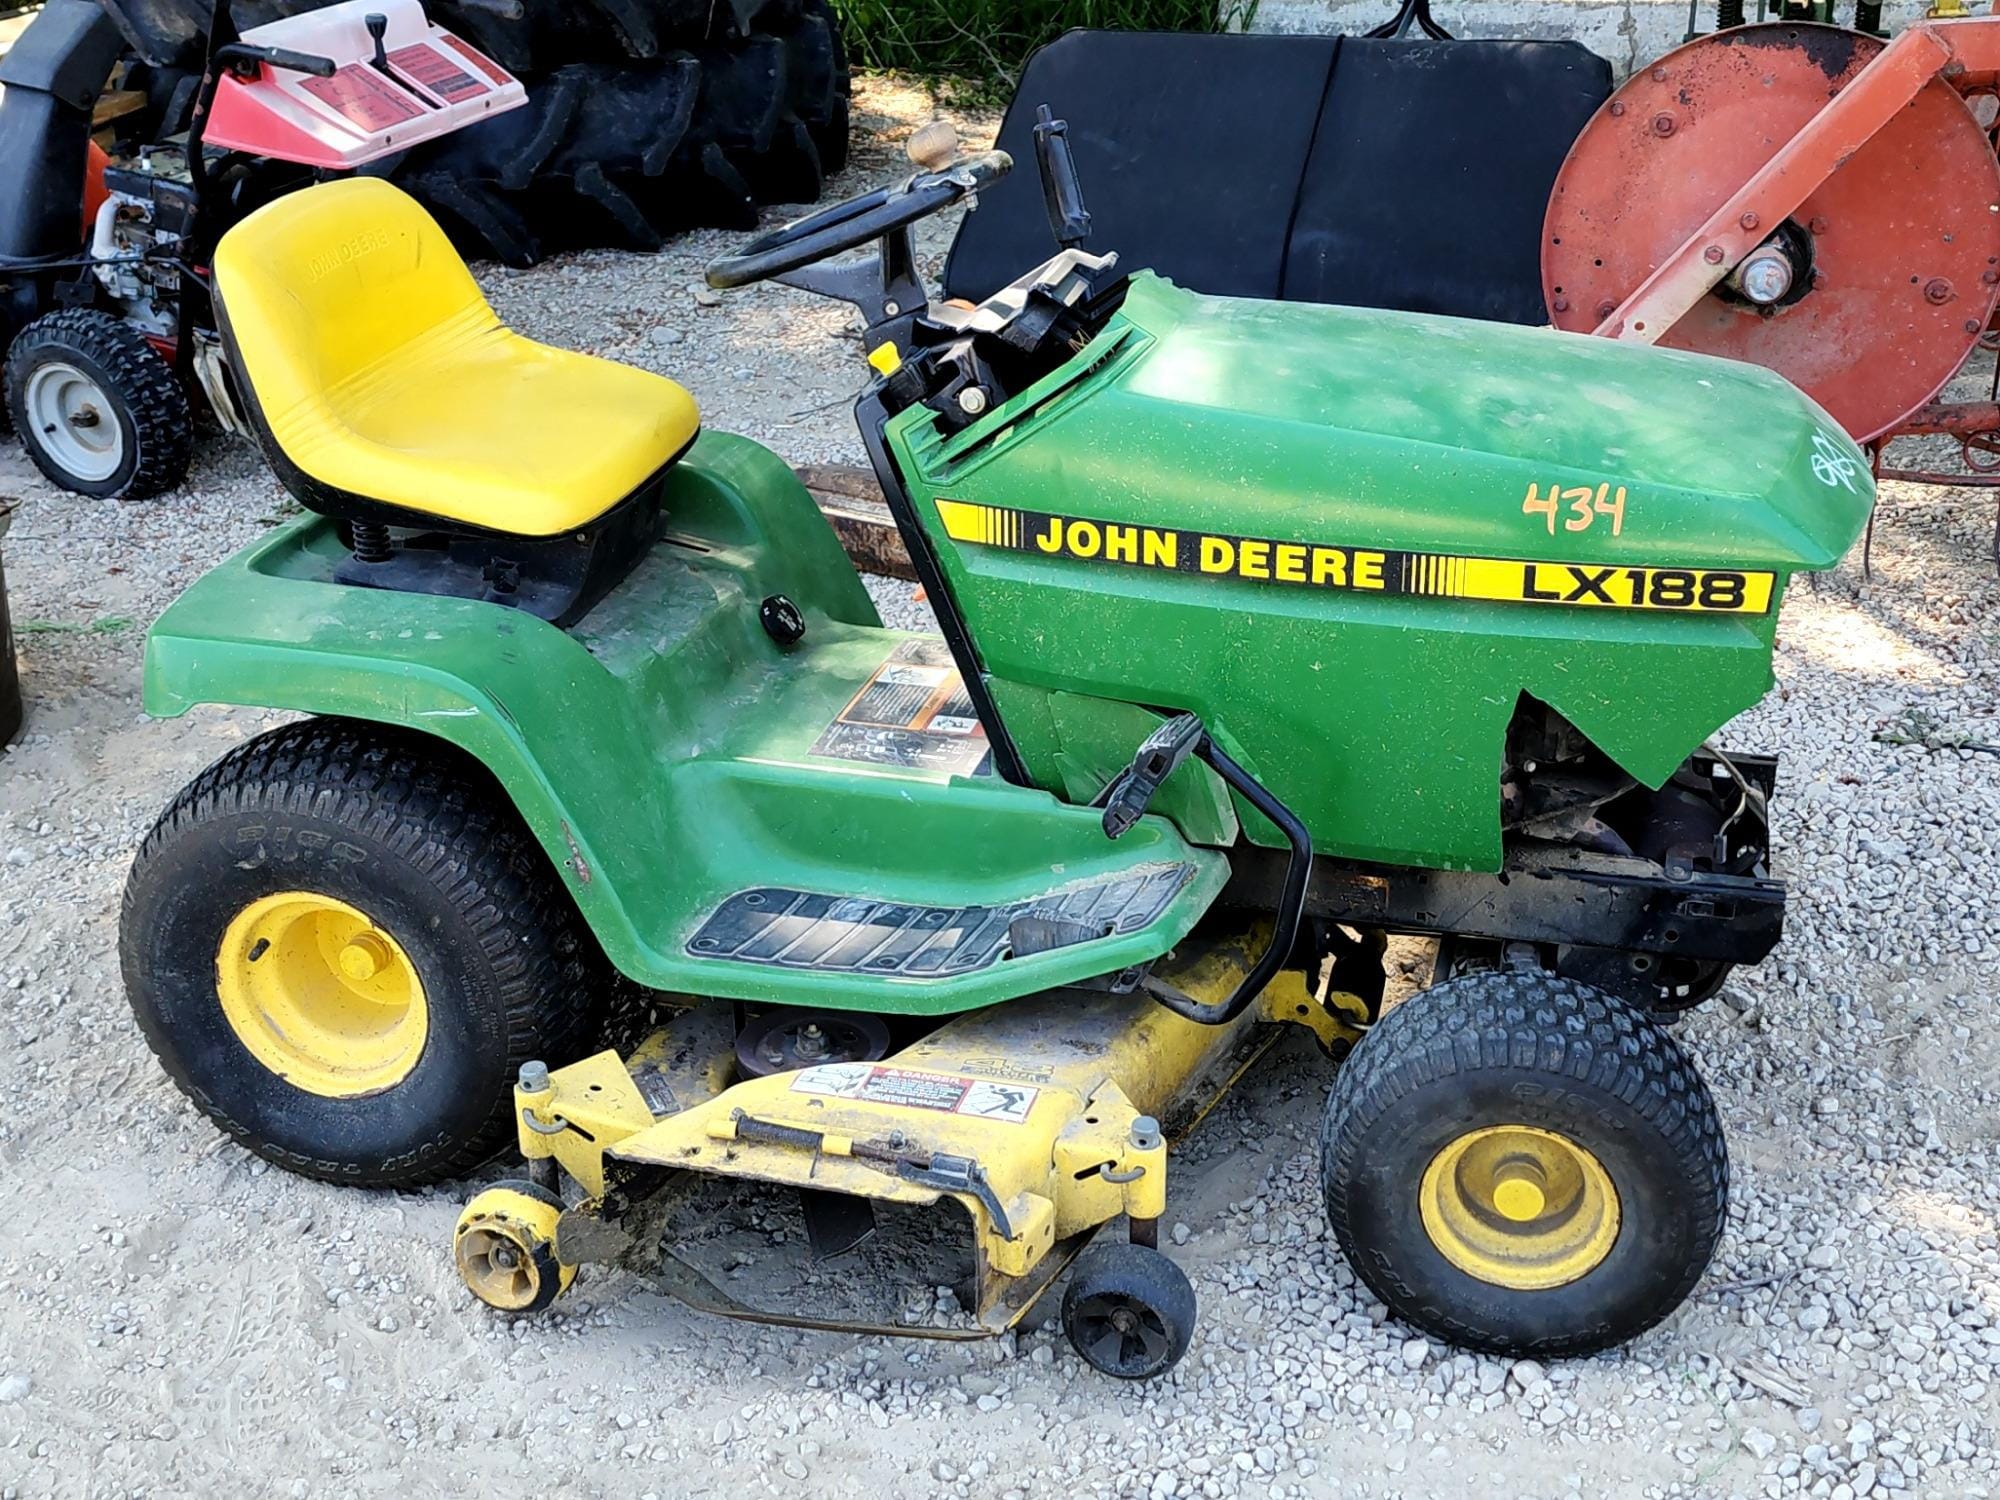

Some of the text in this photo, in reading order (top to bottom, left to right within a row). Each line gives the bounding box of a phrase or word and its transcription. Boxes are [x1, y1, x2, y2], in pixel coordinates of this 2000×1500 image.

[1522, 482, 1626, 536] 434
[1036, 518, 1746, 609] JOHN DEERE LX188
[902, 1070, 961, 1084] DANGER
